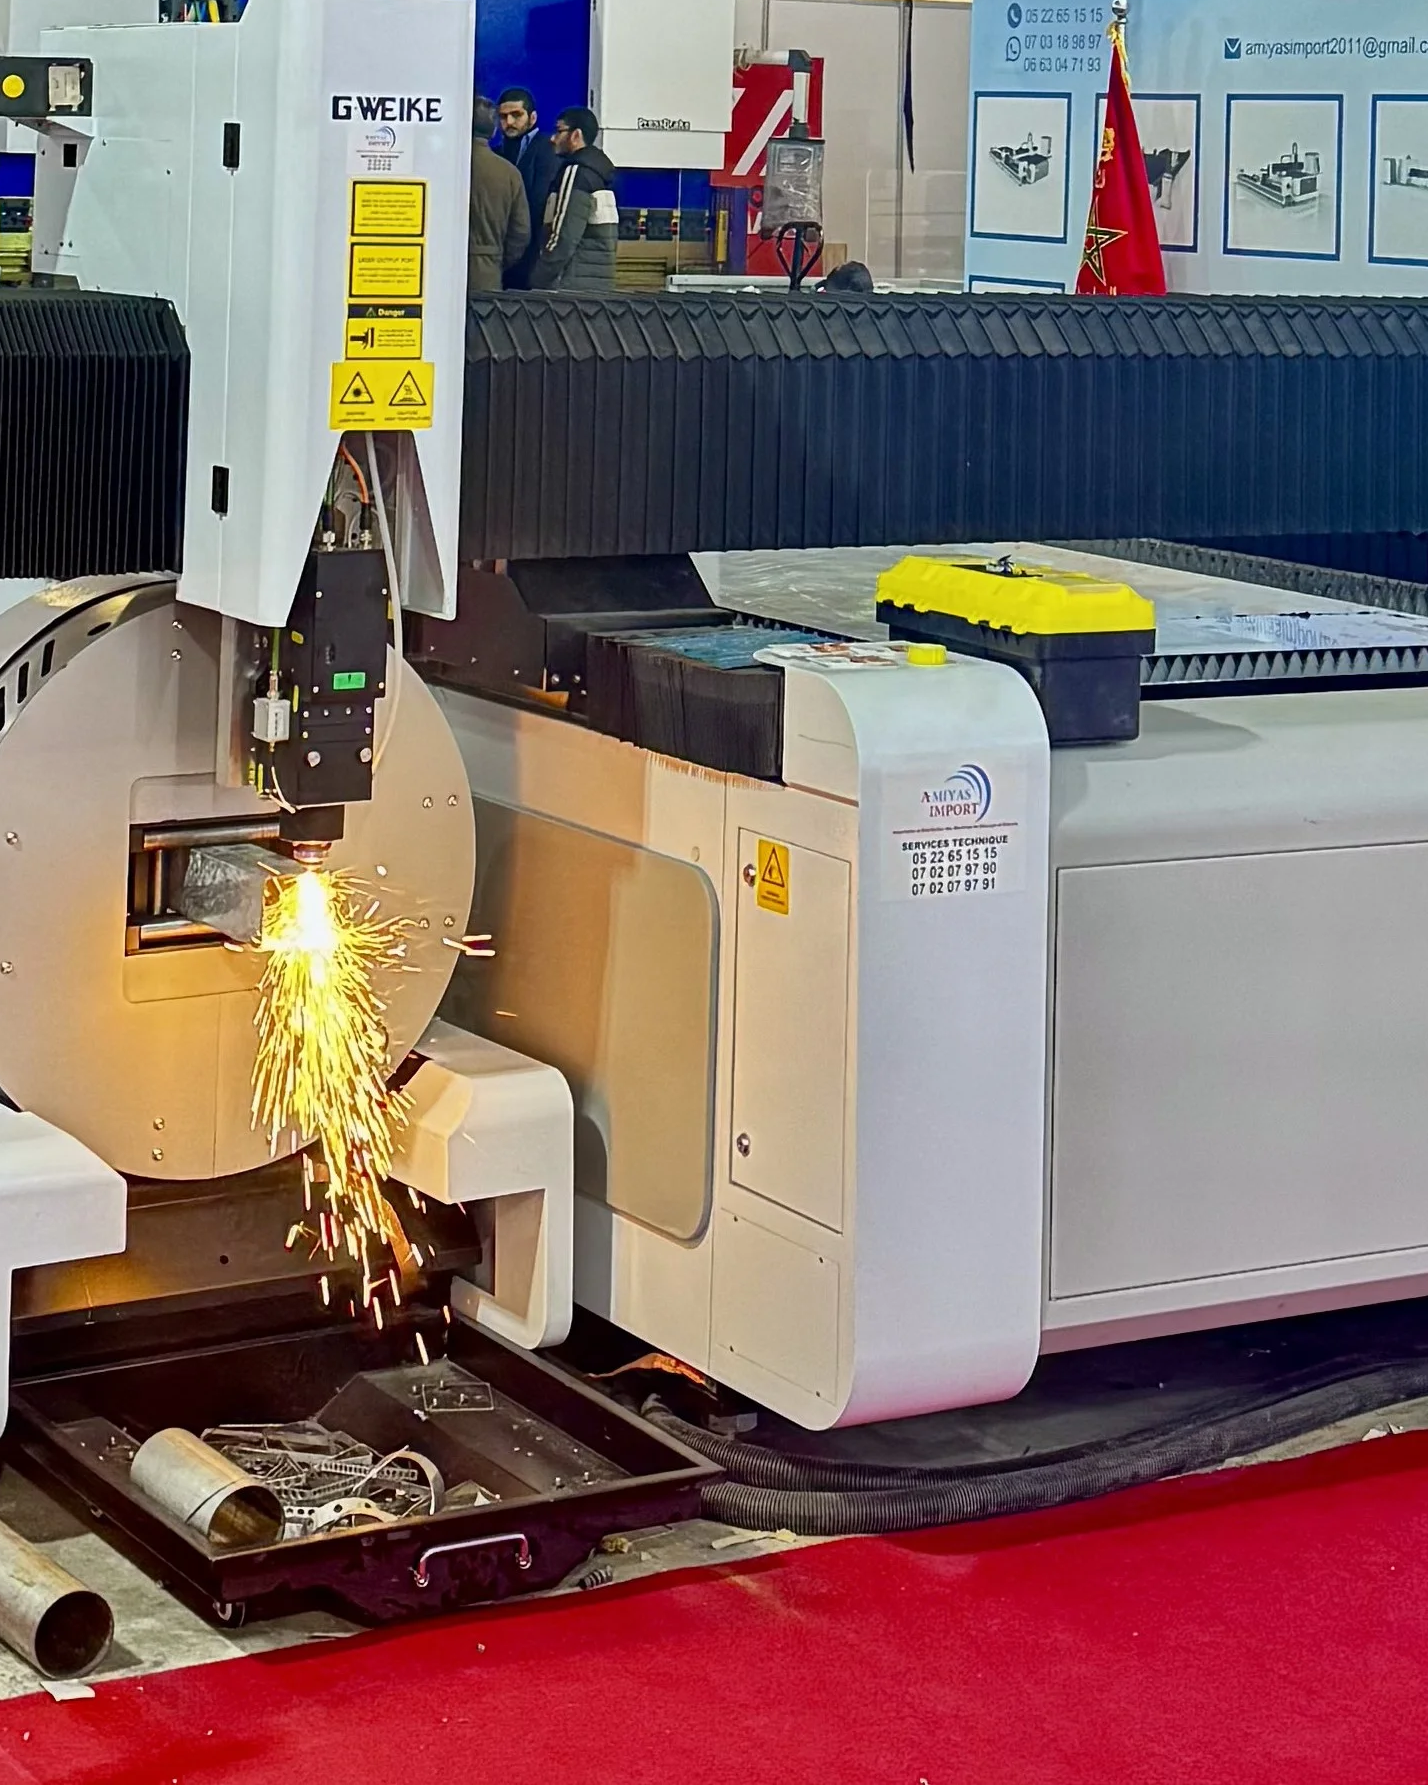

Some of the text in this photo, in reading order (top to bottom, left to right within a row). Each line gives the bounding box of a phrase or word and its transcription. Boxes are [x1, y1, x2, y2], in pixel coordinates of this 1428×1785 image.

[1041, 8, 1053, 23] 22
[1056, 8, 1070, 23] 65
[1074, 8, 1087, 23] 15
[1090, 8, 1103, 23] 15
[1024, 34, 1102, 50] 07 03 18 98 97
[1055, 57, 1068, 72] 04
[1071, 57, 1083, 72] 71
[1087, 57, 1100, 72] 93
[378, 308, 406, 317] Danger
[921, 789, 972, 803] AMIYAS
[929, 802, 979, 817] IMPORT
[902, 835, 1008, 851] SERVICES TECHNIQUE
[912, 846, 998, 865] 05 22 65 15 15
[912, 861, 997, 880] 07 02 07 97 90
[912, 877, 996, 896] 07 02 07 97 91
